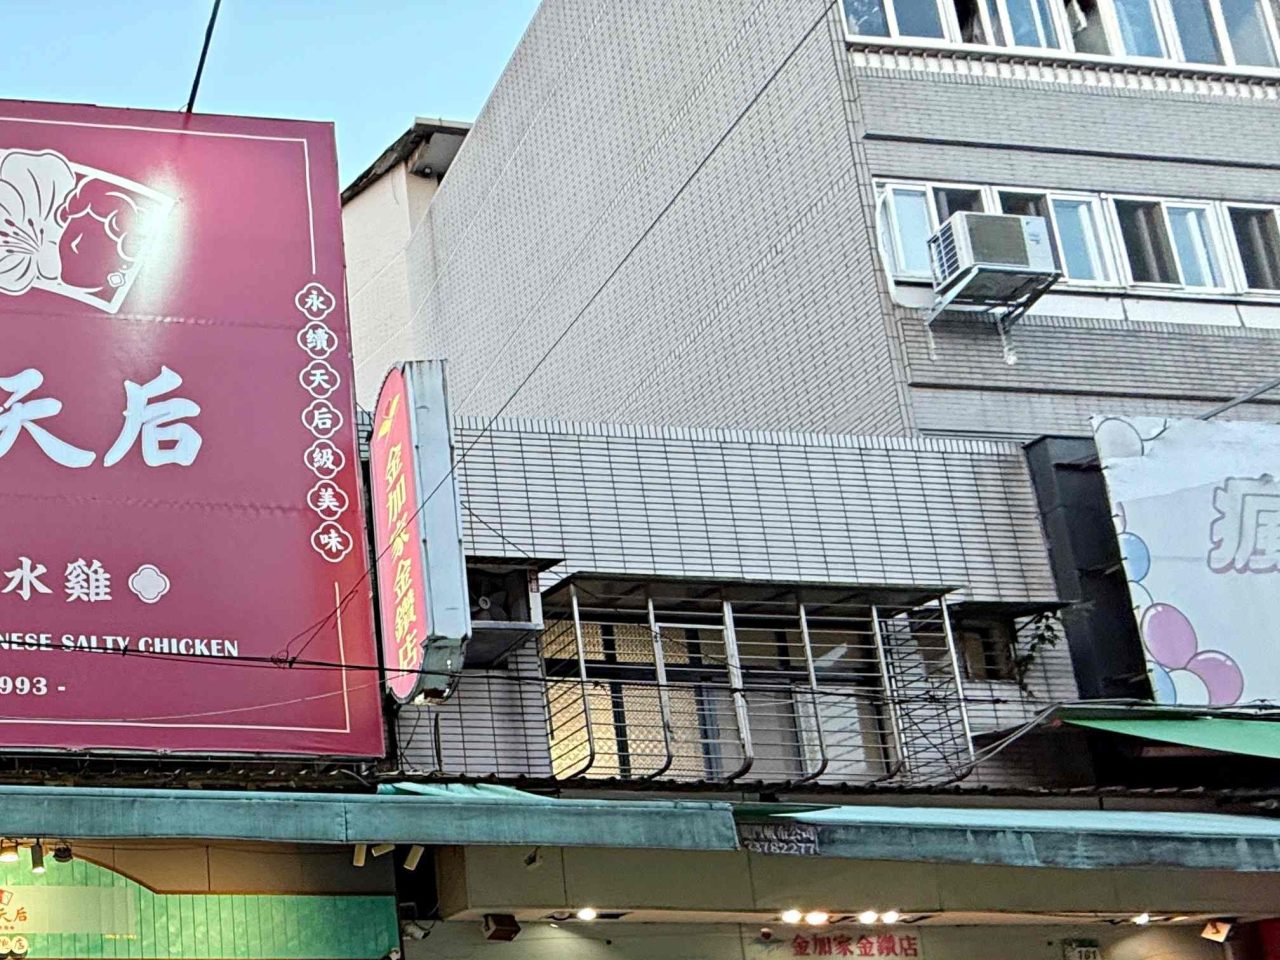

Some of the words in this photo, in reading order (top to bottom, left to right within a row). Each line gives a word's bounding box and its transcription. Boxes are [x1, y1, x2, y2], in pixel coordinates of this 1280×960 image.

[304, 290, 343, 553] 永續天后級美味
[61, 634, 130, 655] SALTY
[138, 637, 239, 658] CHICKEN
[385, 441, 419, 677] 金加家金鑽店
